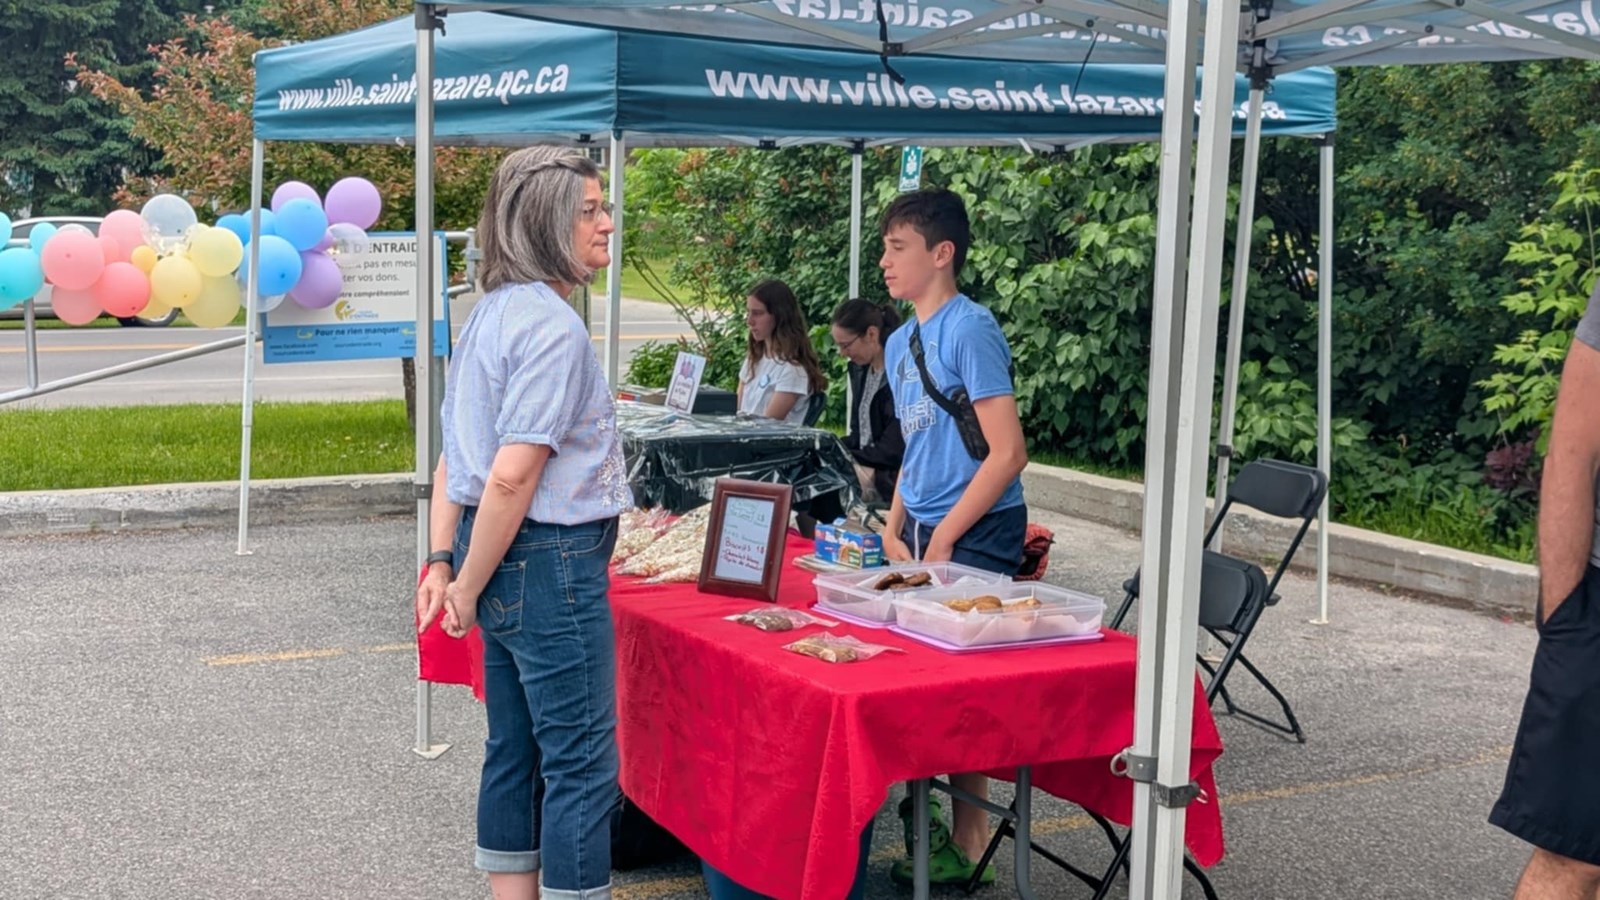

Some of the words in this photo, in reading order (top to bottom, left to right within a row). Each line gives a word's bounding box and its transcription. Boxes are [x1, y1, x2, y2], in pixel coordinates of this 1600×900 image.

[278, 63, 569, 111] www.ville.saintazare.qc.ca
[363, 261, 379, 269] pas
[357, 274, 373, 282] vos
